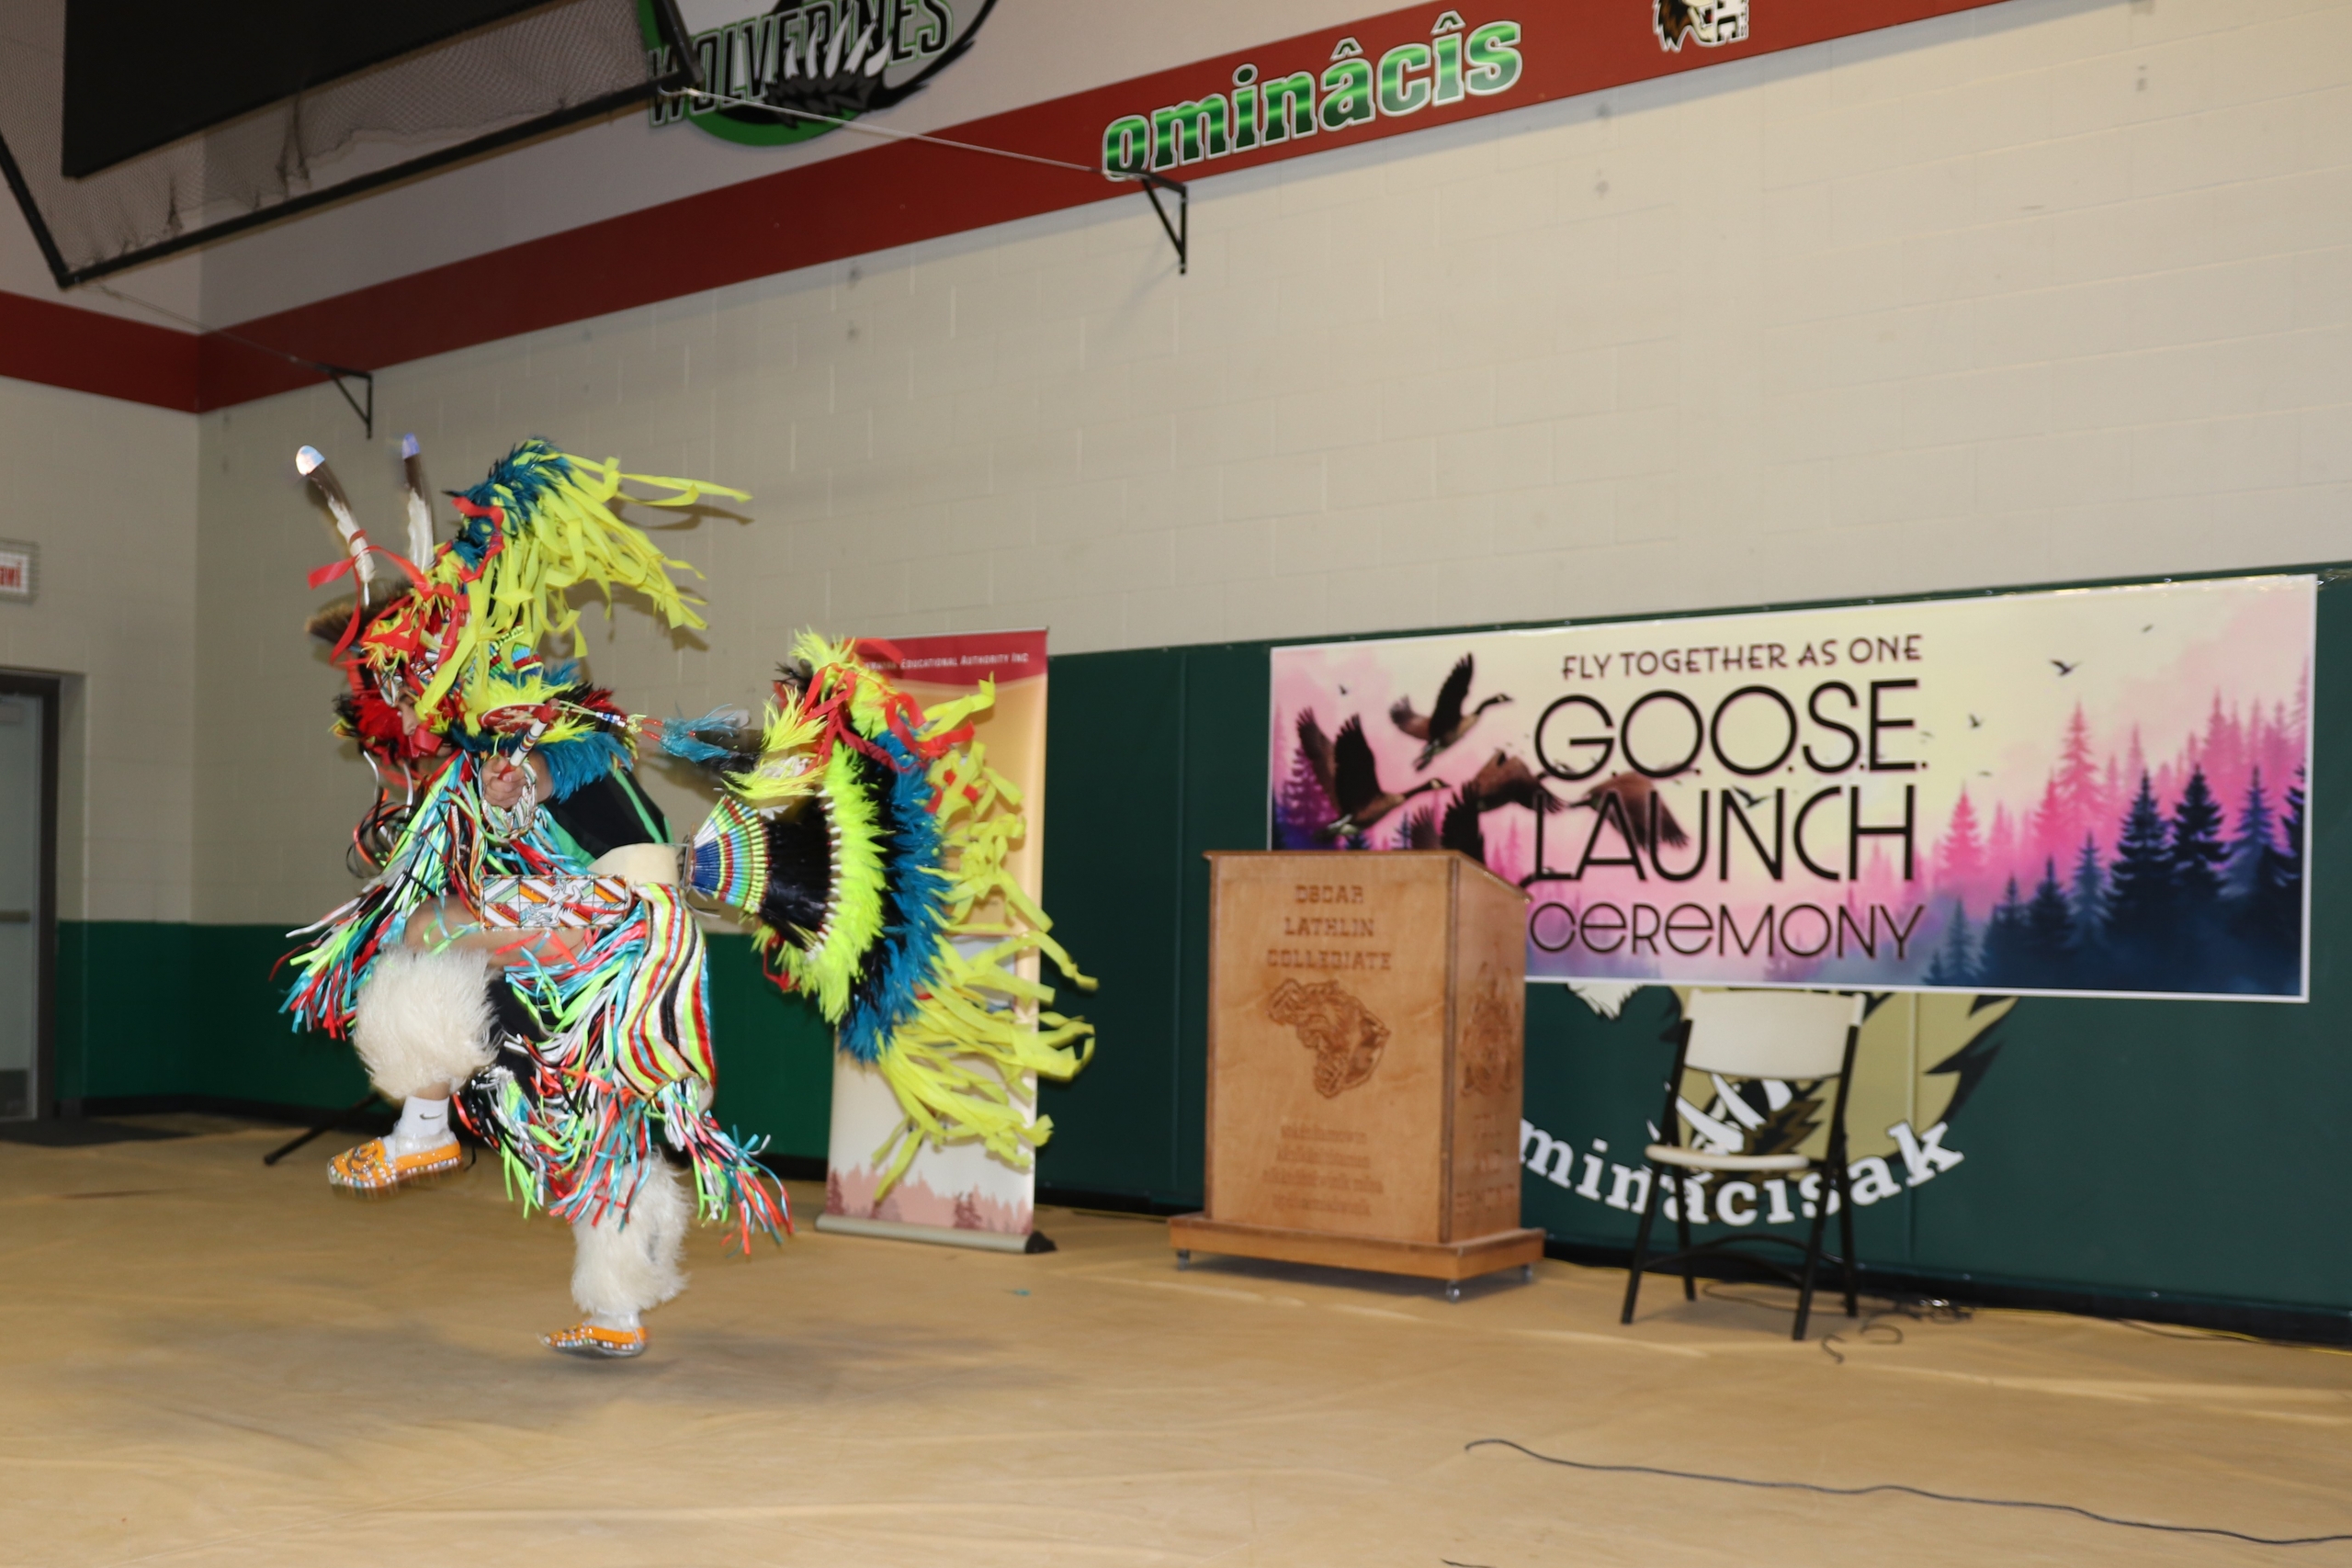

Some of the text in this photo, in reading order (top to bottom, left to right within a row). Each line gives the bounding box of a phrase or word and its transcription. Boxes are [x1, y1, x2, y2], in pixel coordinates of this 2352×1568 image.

[1102, 10, 1522, 182] ominâcîs
[900, 658, 958, 670] EDUCATIONAL
[960, 654, 1010, 666] AUTHORITY
[1012, 651, 1029, 663] INC
[1562, 634, 1924, 681] FLY TOGETHER AS ONE
[1533, 784, 1917, 883] LAUNCH
[1295, 885, 1364, 904] OSCAR
[1284, 916, 1375, 938] LATHLIN
[1266, 948, 1392, 971] COLLEGIATE
